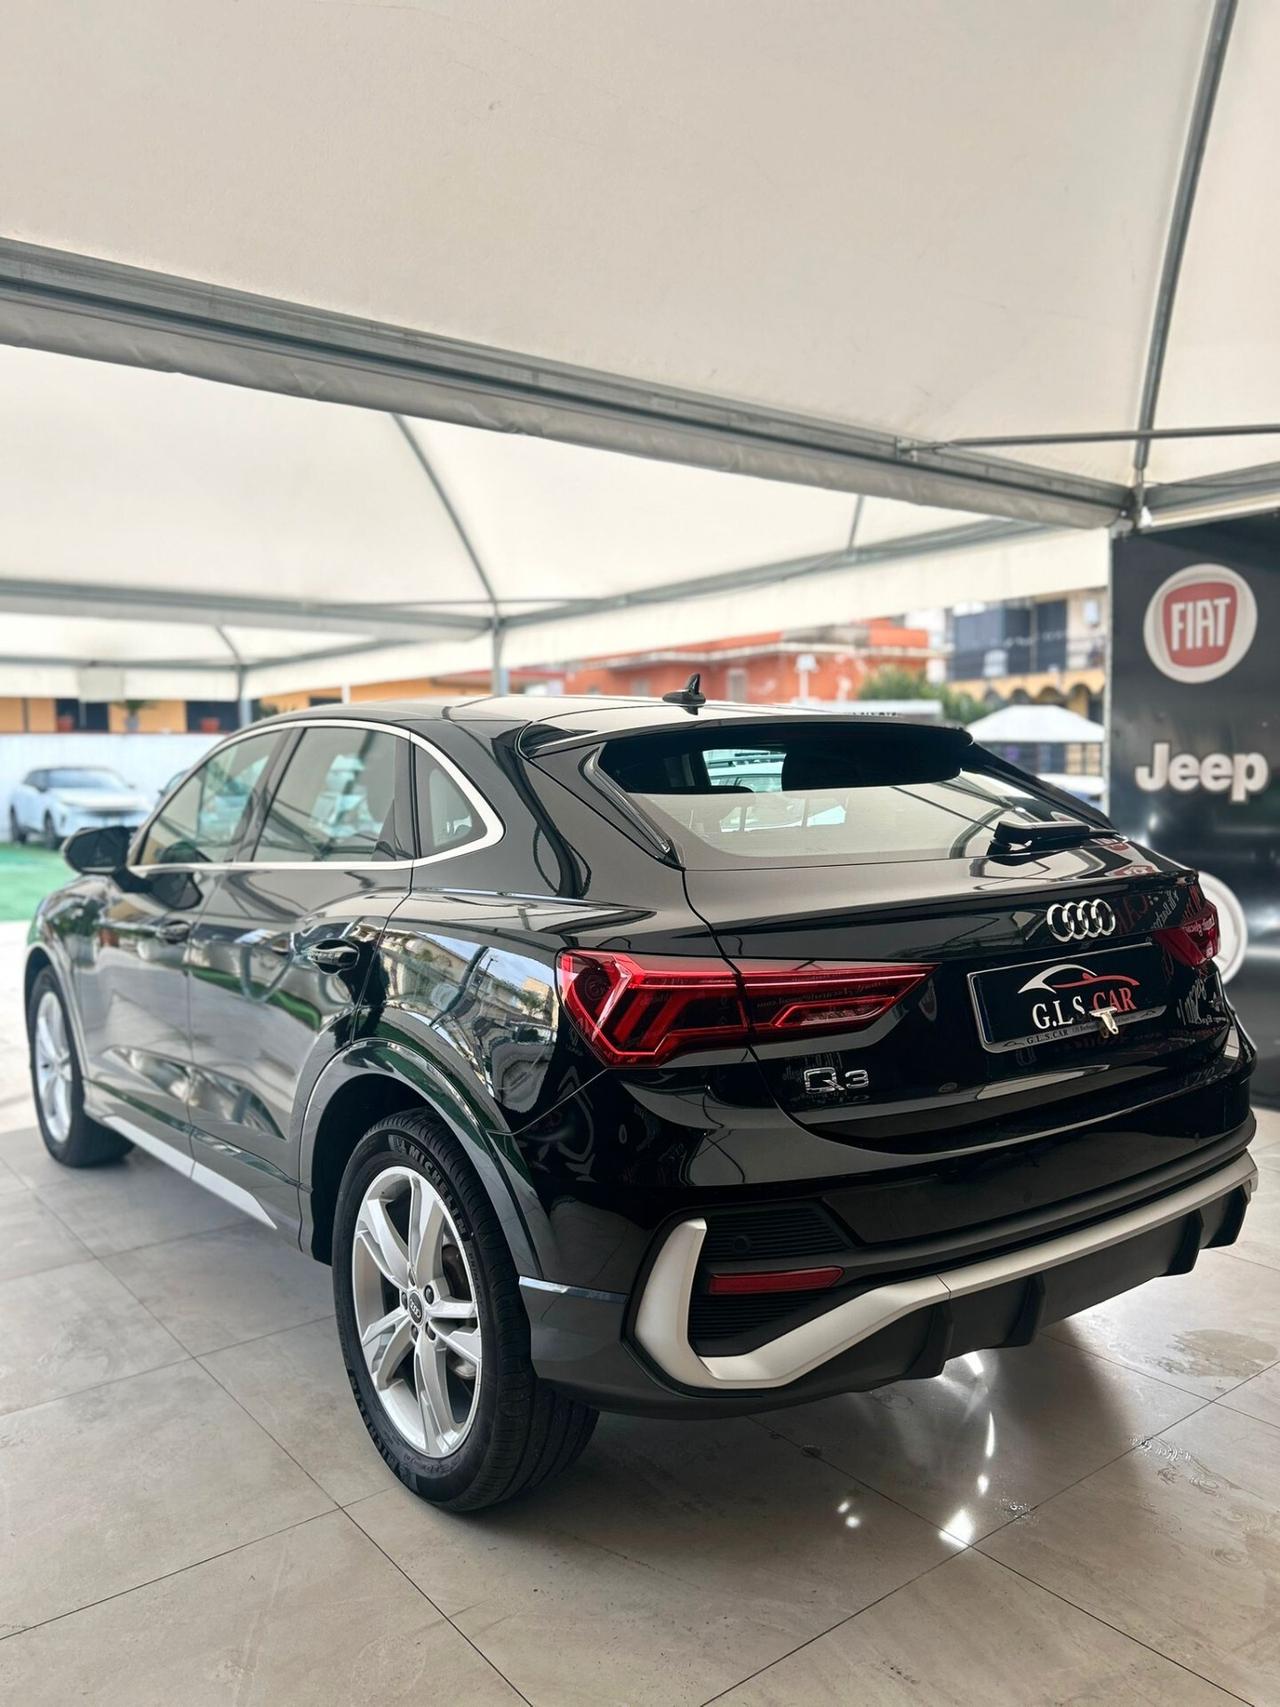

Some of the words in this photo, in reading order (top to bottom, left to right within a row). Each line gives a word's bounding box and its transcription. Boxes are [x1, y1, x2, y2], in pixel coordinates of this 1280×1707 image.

[1171, 597, 1230, 651] FIAT
[1135, 743, 1269, 802] Jeep
[1032, 995, 1085, 1030] G.LS
[1092, 987, 1137, 1014] CAR
[804, 1066, 869, 1094] Q3
[408, 1143, 468, 1236] MICHELIN
